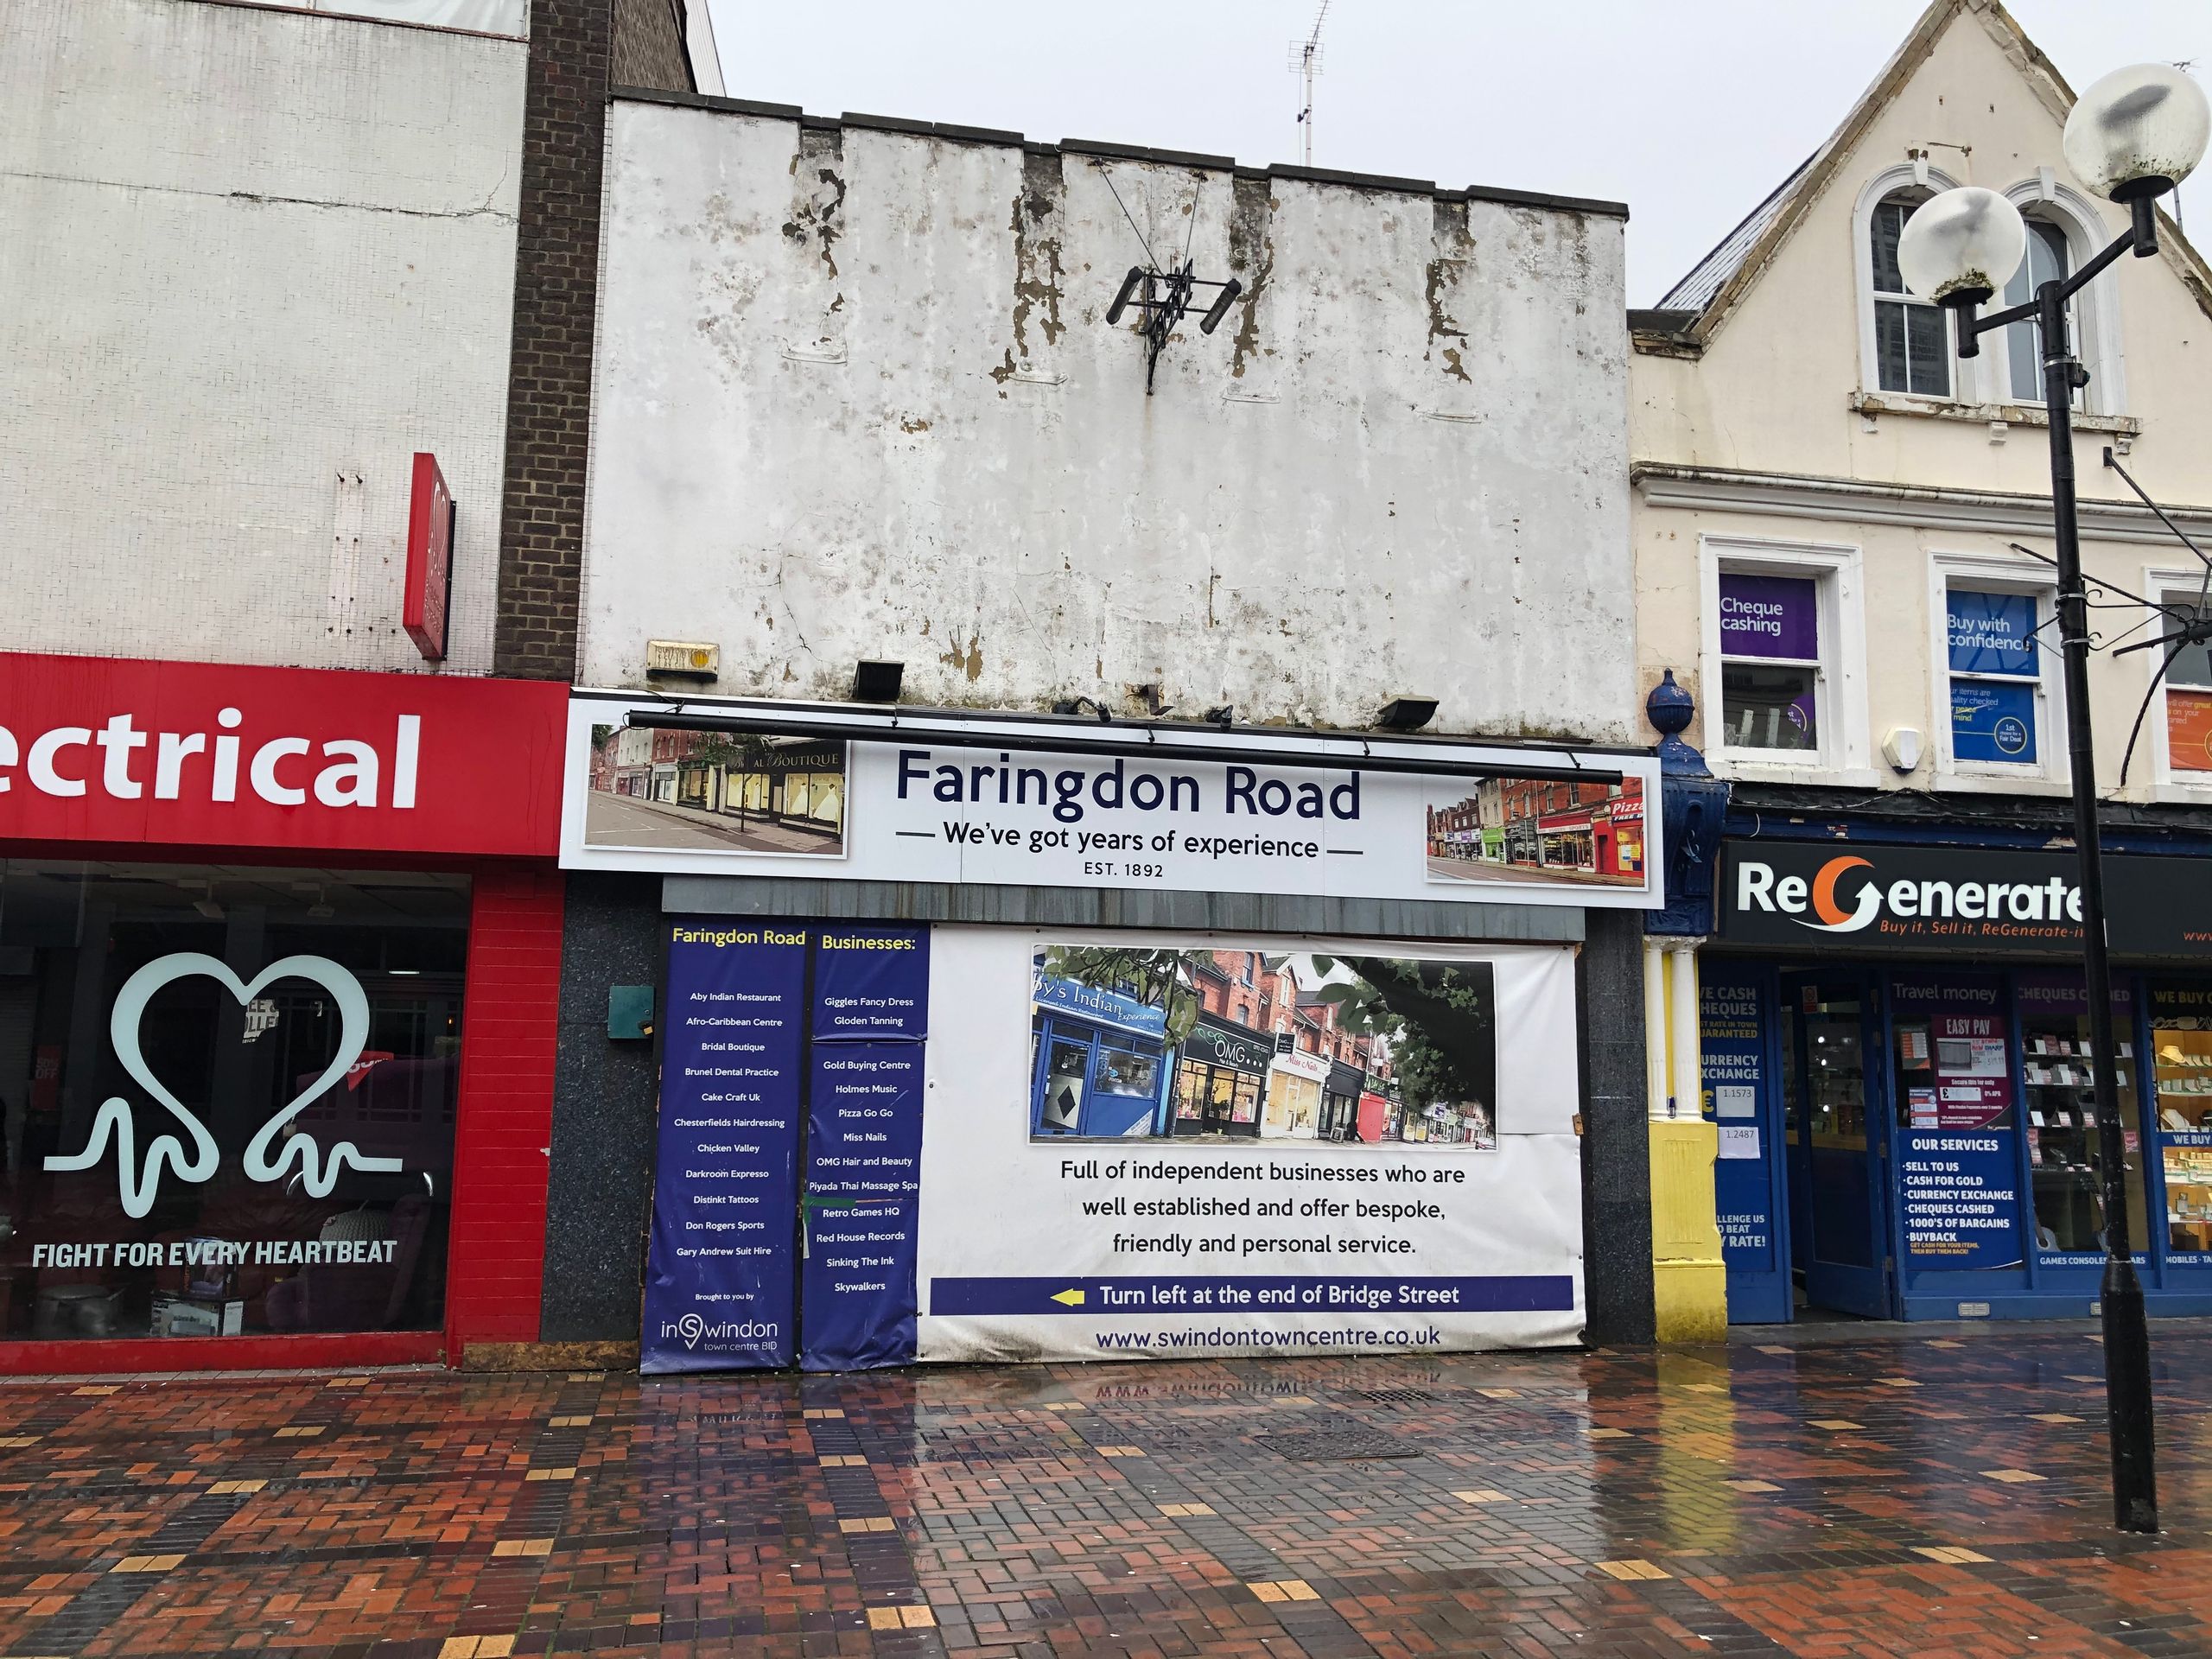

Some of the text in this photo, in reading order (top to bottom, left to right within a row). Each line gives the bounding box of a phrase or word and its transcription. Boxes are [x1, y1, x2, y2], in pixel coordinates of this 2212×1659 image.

[1720, 597, 1783, 618] Cheque
[1721, 616, 1781, 636] cashing
[1948, 613, 2010, 632] Buy with
[0, 707, 421, 809] ctrical
[897, 749, 1360, 823] Faringdon Road
[944, 821, 1319, 860] We've got years of experience
[1085, 862, 1163, 878] EST. 1892
[1880, 920, 1906, 936] Buy
[1911, 921, 1925, 935] it,
[1932, 921, 1958, 934] Sell
[1962, 923, 1976, 936] it,
[673, 927, 915, 950] Faringdon Road Businesses:
[690, 993, 708, 1002] Aby
[736, 994, 781, 1002] Restaurant
[1718, 987, 1757, 1000] CASH
[1893, 983, 1997, 1005] Travel money
[2154, 991, 2203, 1004] WE BUY
[825, 997, 857, 1007] Giggles
[861, 998, 886, 1007] Fancy
[1073, 986, 1122, 1014] Indian
[1700, 1002, 1757, 1019] HEQUES
[686, 1017, 782, 1027] Afro-Caribbean Centre
[835, 1016, 903, 1027] Gloden Tanning
[1118, 1012, 1160, 1021] Experience
[1946, 1019, 1990, 1035] EASY PAY
[728, 1043, 765, 1053] Boutique
[1701, 1054, 1758, 1065] URRENCY
[823, 1061, 911, 1071] Gold Buying Centre
[685, 1068, 779, 1077] Brunel Dental Practice
[1700, 1068, 1759, 1079] XCHANGE
[836, 1084, 897, 1093] Holmes Music
[702, 1093, 760, 1102] Cake Craft Uk
[839, 1109, 861, 1117] Pizza
[675, 1118, 785, 1128] Chesterfields Hairdressing
[844, 1133, 887, 1141] Miss Nails
[2173, 1135, 2211, 1144] WE BUY
[697, 1144, 760, 1154] Chicken Valley
[1912, 1139, 1999, 1151] OUR SERVICES
[817, 1157, 912, 1166] OMG Hair and Beauty
[1905, 1162, 1959, 1172] SELL TO US
[731, 1170, 769, 1179] Expresso
[1061, 1160, 1465, 1185] Full of independent businesses who are
[1907, 1176, 1983, 1185] CASH FOR GOLD
[810, 1181, 918, 1192] Piyada Thai Massage Spa
[694, 1195, 759, 1204] Distinkt Tattoos
[1907, 1190, 2013, 1200] CURRENCY EXCHANGE
[823, 1207, 899, 1217] Retro Games HQ
[1083, 1197, 1445, 1223] well established and offer bespoke,
[1908, 1205, 1994, 1216] CHEQUES CASHED
[686, 1221, 765, 1232] Don Rogers Sports
[1726, 1224, 1750, 1233] BEAT
[1909, 1218, 2009, 1228] 1000'S OF BARGAINS
[817, 1232, 905, 1243] Red House Records
[1730, 1236, 1765, 1247] RATE!
[1910, 1233, 1956, 1242] BUYBACK
[1113, 1233, 1416, 1257] friendly and personal service.
[33, 1240, 397, 1268] FIGHT FOR EVERY HEARTBEAT
[677, 1247, 771, 1257] Gary Andrew Suit Hire
[827, 1256, 893, 1268] Sinking The Ink
[835, 1282, 886, 1292] Skywalkers
[696, 1294, 721, 1302] Brought
[747, 1293, 753, 1301] by
[1100, 1284, 1459, 1309] Turn left at the end of Bridge Street
[1096, 1325, 1440, 1350] www.swindontowncentre.co.uk
[730, 1342, 759, 1351] centre
[761, 1341, 777, 1351] BID
